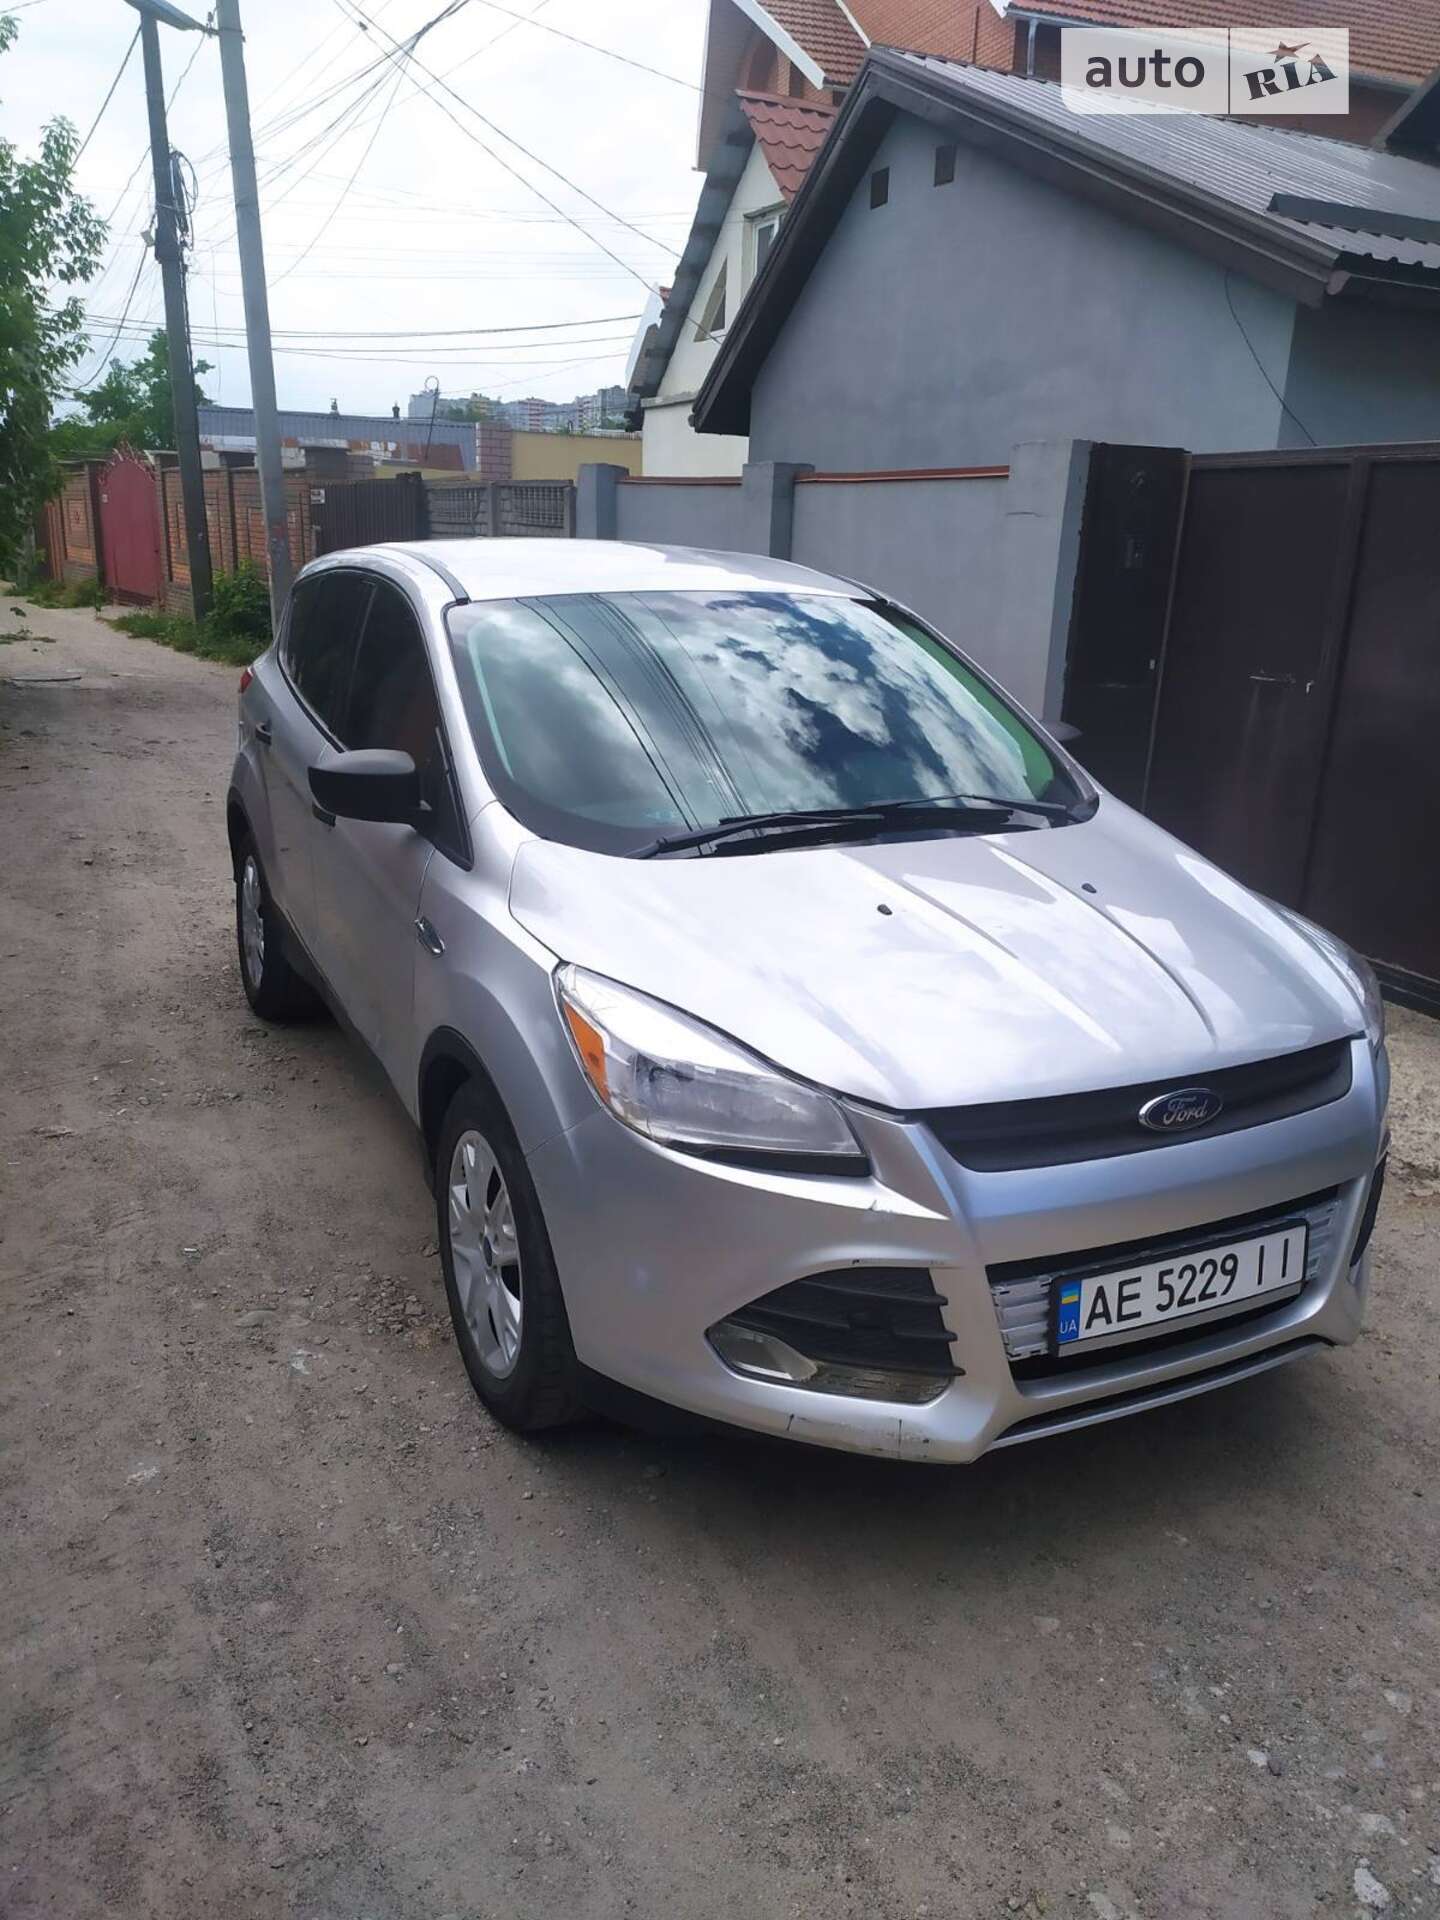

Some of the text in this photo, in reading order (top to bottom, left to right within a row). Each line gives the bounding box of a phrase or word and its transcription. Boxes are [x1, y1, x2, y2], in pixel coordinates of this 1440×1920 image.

[1163, 1096, 1209, 1125] Ford
[1085, 1238, 1289, 1330] AE 5229 II
[1059, 1319, 1078, 1334] UA
